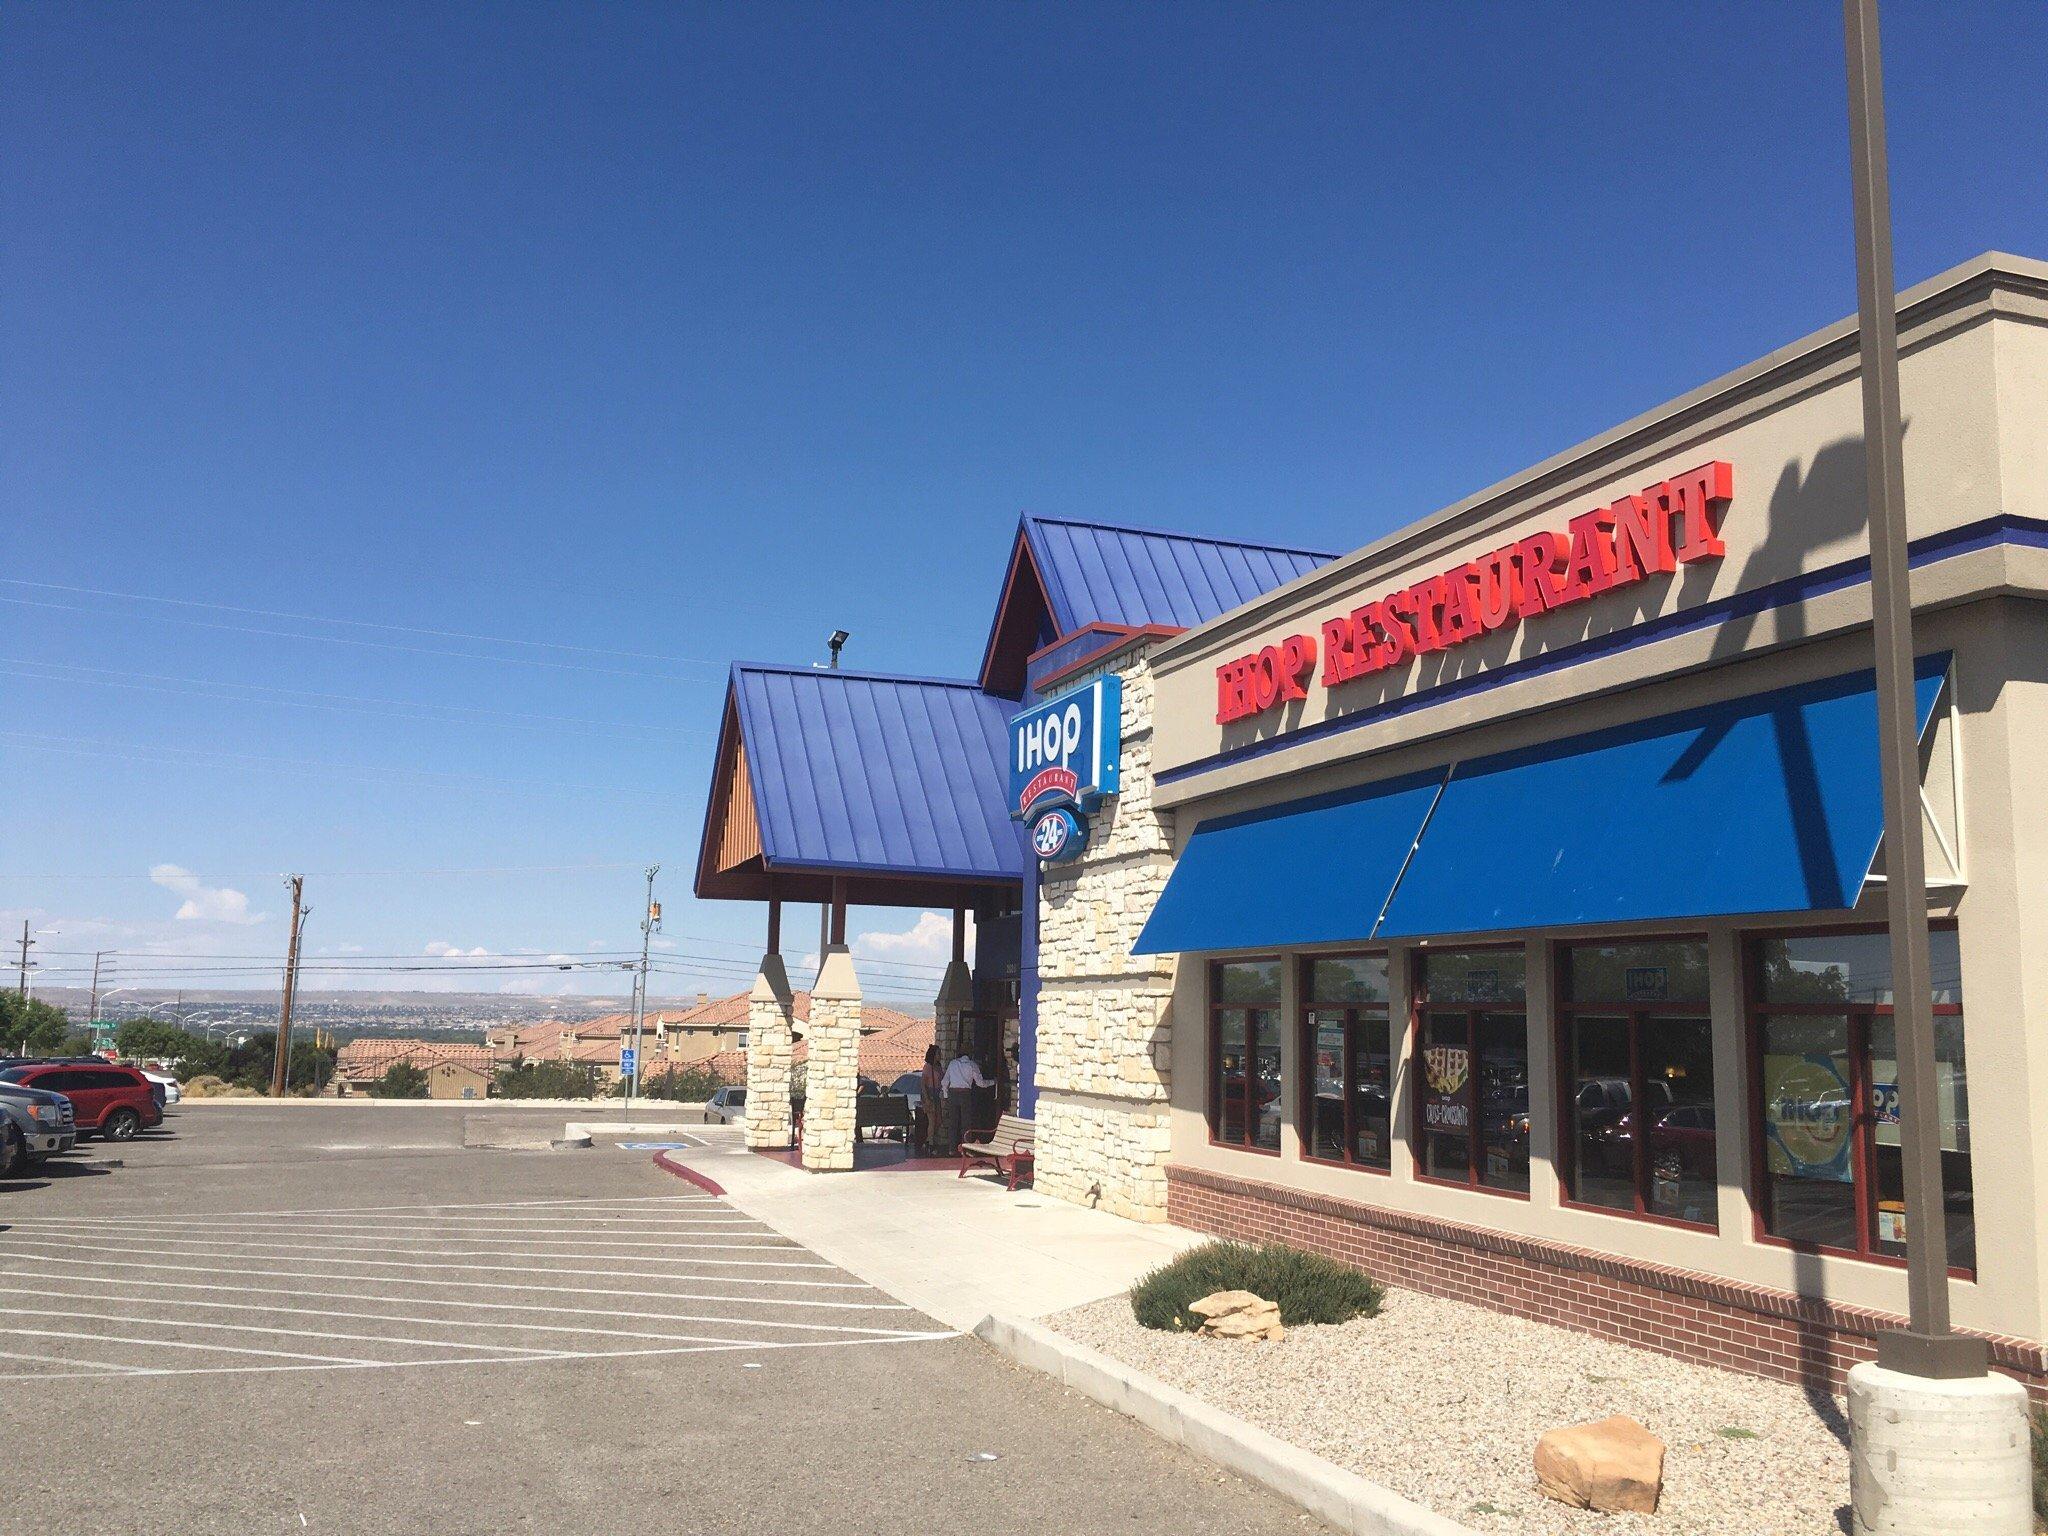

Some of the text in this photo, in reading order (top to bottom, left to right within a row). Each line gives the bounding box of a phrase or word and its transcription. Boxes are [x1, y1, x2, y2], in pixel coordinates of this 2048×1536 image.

[1215, 460, 1733, 725] IHOP RESTAURANT
[1018, 703, 1081, 773] IHOP
[1023, 772, 1075, 806] RESTAURANT
